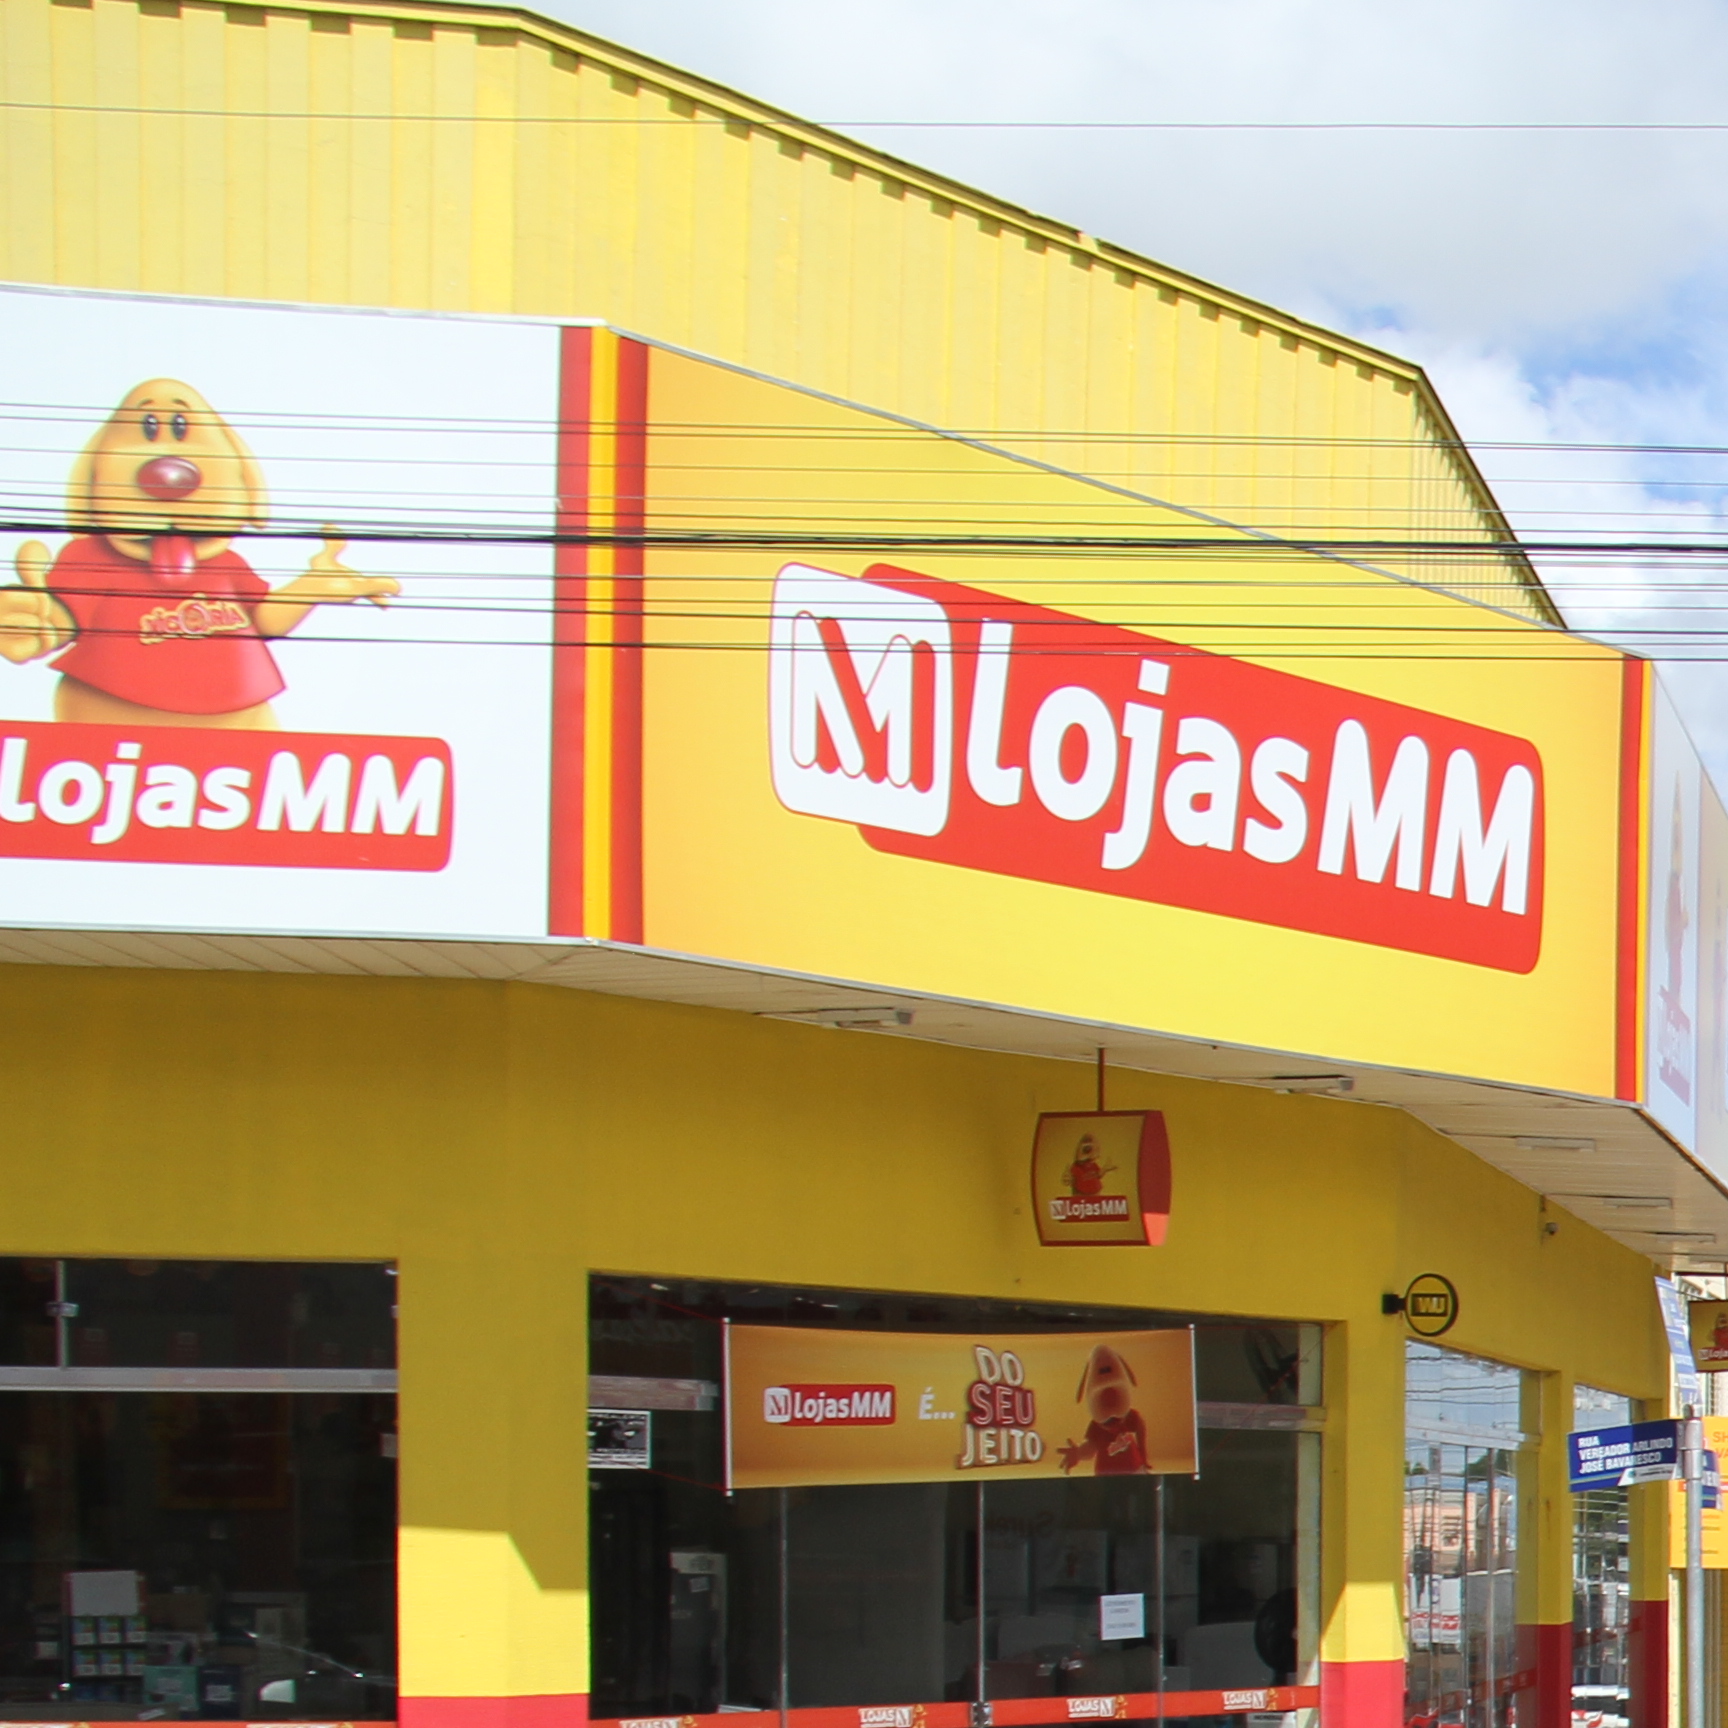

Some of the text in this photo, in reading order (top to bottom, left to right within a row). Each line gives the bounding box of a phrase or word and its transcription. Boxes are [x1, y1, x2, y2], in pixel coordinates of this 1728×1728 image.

[966, 617, 1536, 917] LojasMM
[1066, 1199, 1127, 1220] LojasMM
[974, 1345, 1025, 1387] DO
[793, 1390, 893, 1423] LojasMM
[918, 1385, 956, 1420] É...
[970, 1382, 1034, 1426] SEU
[960, 1423, 1043, 1468] JEITO
[1578, 1435, 1600, 1449] RUA
[1578, 1437, 1674, 1461] VEREADOR ARLINDO
[1579, 1451, 1662, 1475] JOSÉ BAVARESCO
[860, 1708, 895, 1723] LOJAS
[1068, 1698, 1100, 1713] LOJAS
